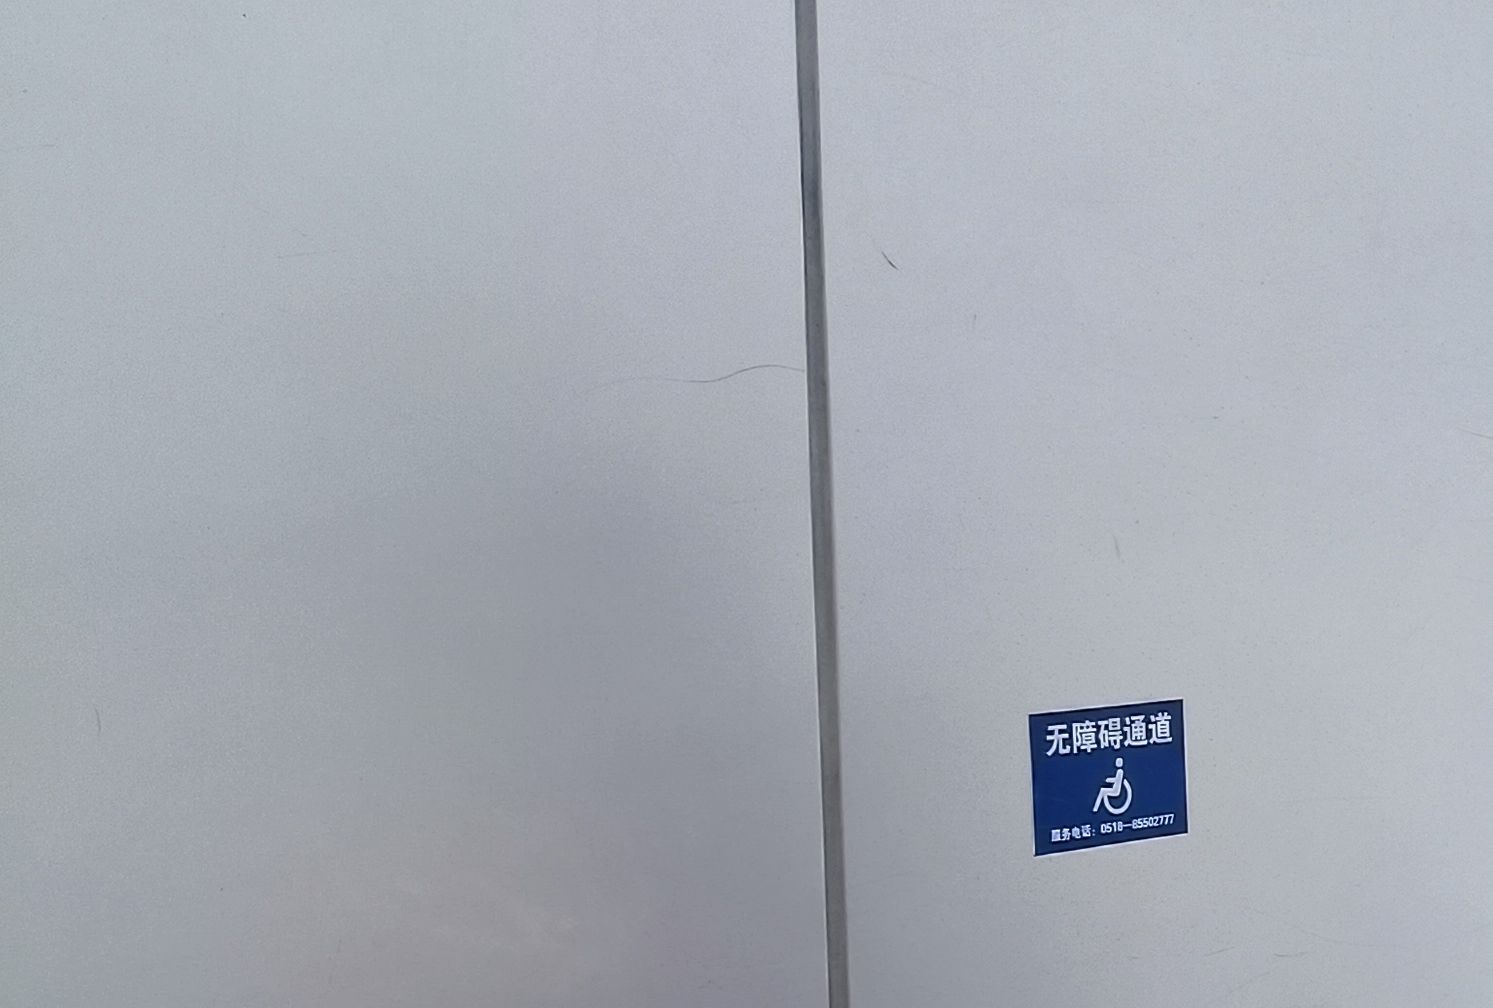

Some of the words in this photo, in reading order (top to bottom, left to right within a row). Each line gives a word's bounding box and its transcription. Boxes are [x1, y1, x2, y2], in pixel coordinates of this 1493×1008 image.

[1046, 711, 1173, 757] 无障碍通道
